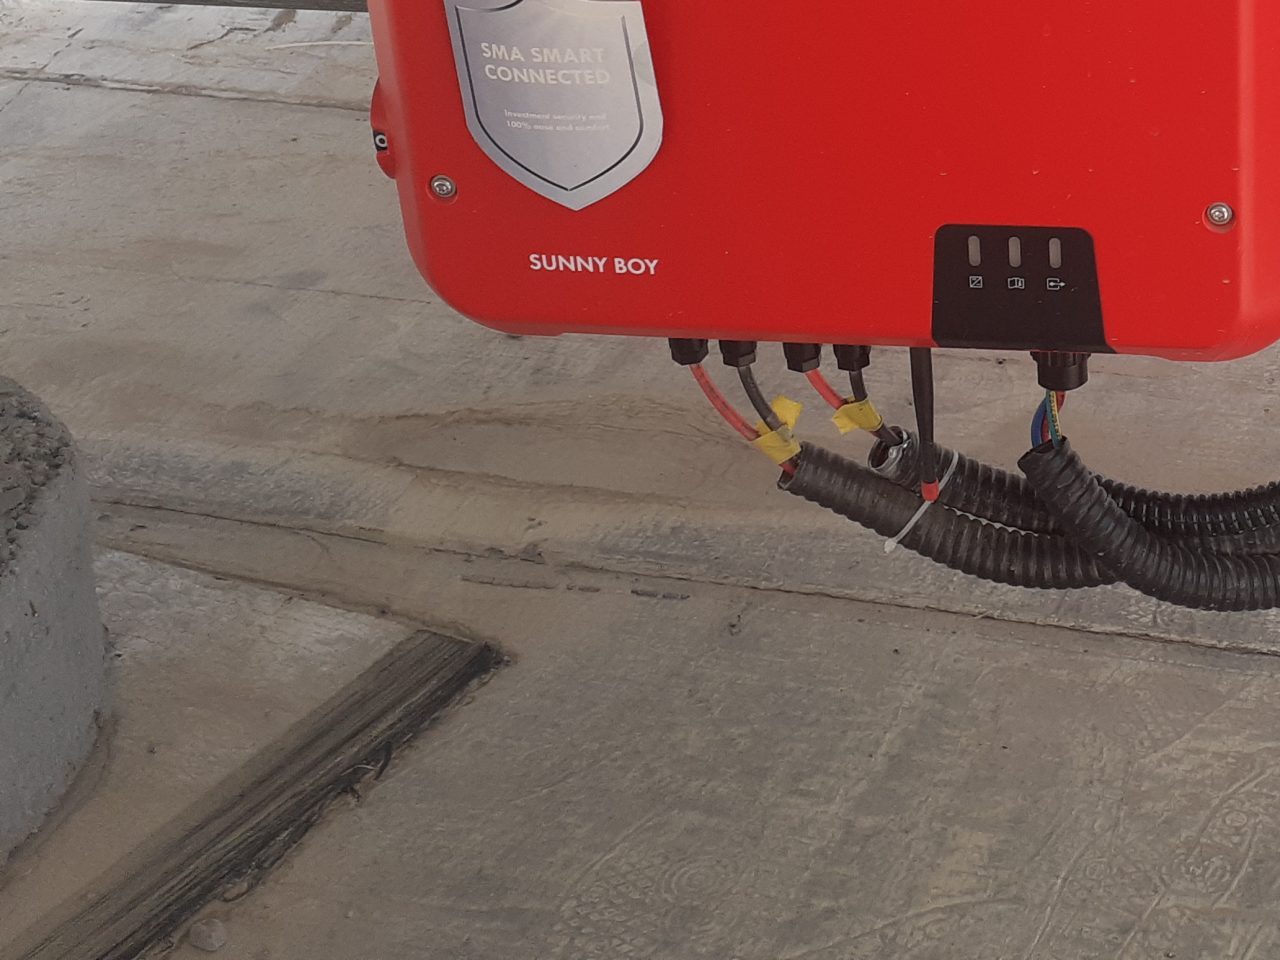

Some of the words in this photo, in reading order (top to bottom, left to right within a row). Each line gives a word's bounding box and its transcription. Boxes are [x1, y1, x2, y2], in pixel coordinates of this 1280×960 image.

[481, 42, 525, 63] SMA
[531, 46, 605, 64] SMART
[485, 64, 610, 86] CONNECTED
[529, 253, 606, 274] SUNNY
[614, 256, 659, 276] BOY
